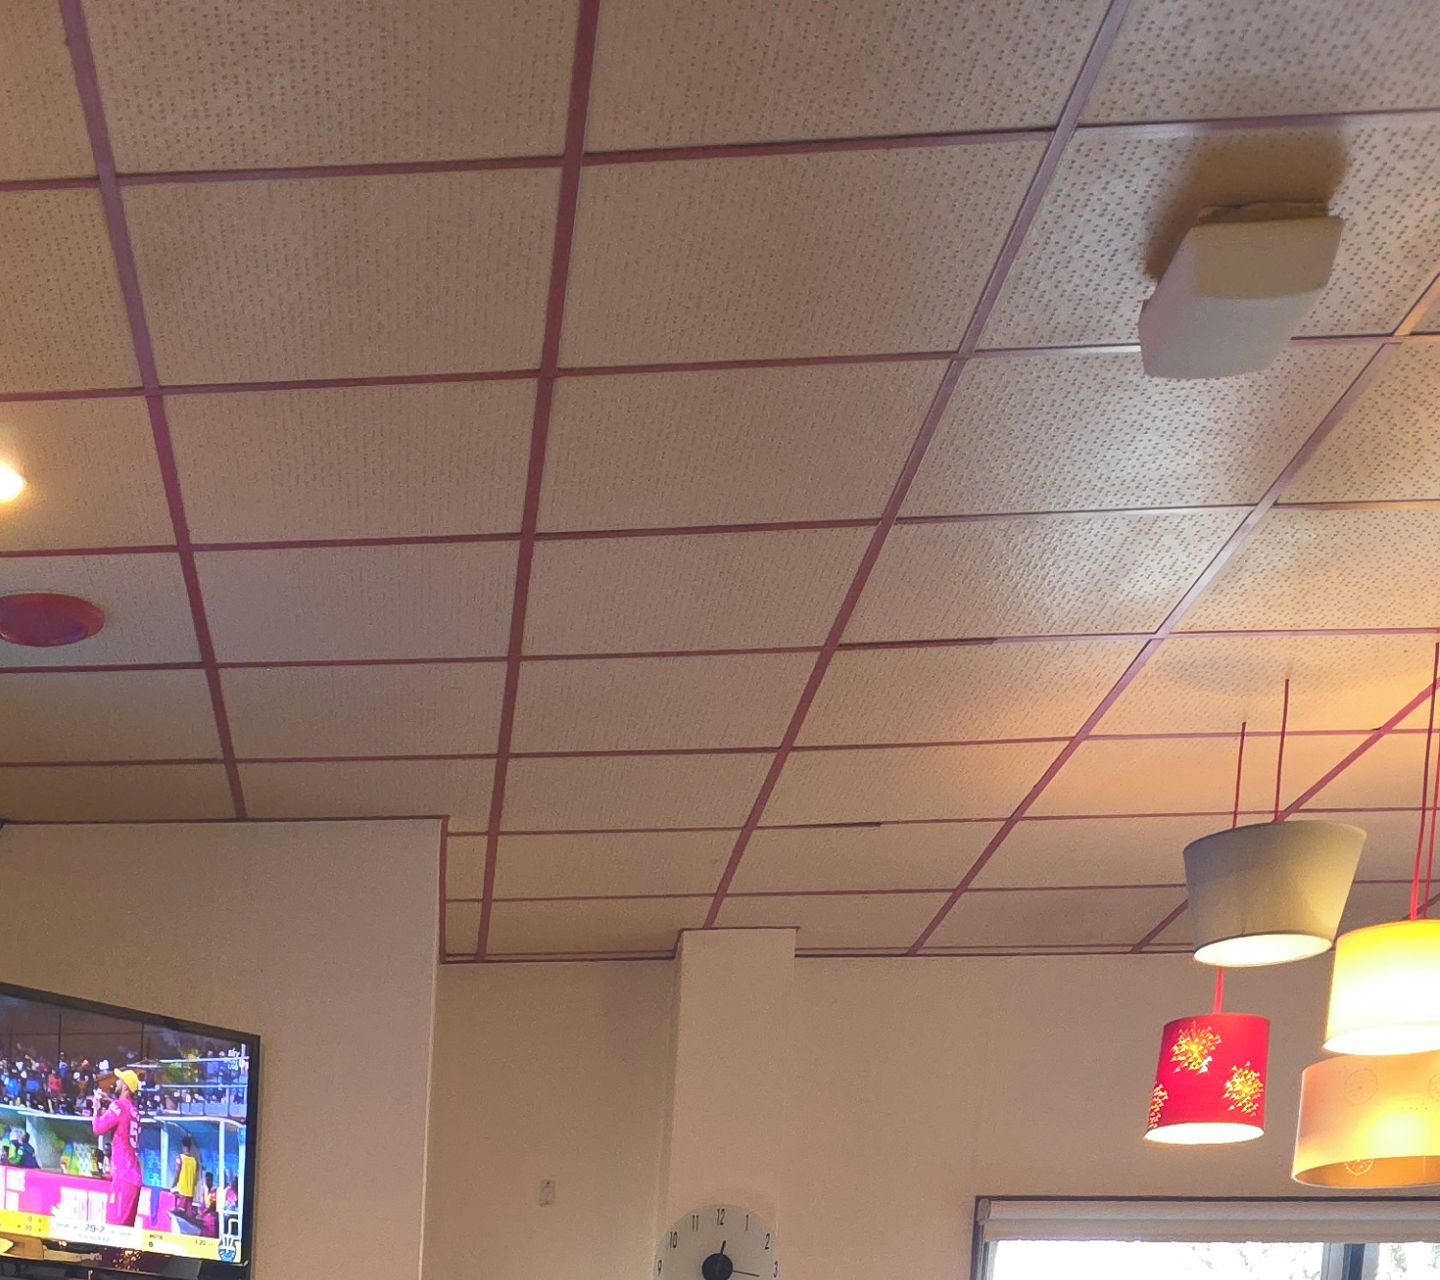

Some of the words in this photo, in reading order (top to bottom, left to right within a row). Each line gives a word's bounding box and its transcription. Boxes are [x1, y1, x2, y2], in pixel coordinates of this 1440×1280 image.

[692, 1215, 699, 1232] 11
[717, 1208, 726, 1225] 12
[745, 1214, 749, 1231] 1
[669, 1231, 678, 1248] 10
[764, 1233, 770, 1250] 2
[657, 1260, 662, 1277] 9
[773, 1260, 778, 1277] 3
